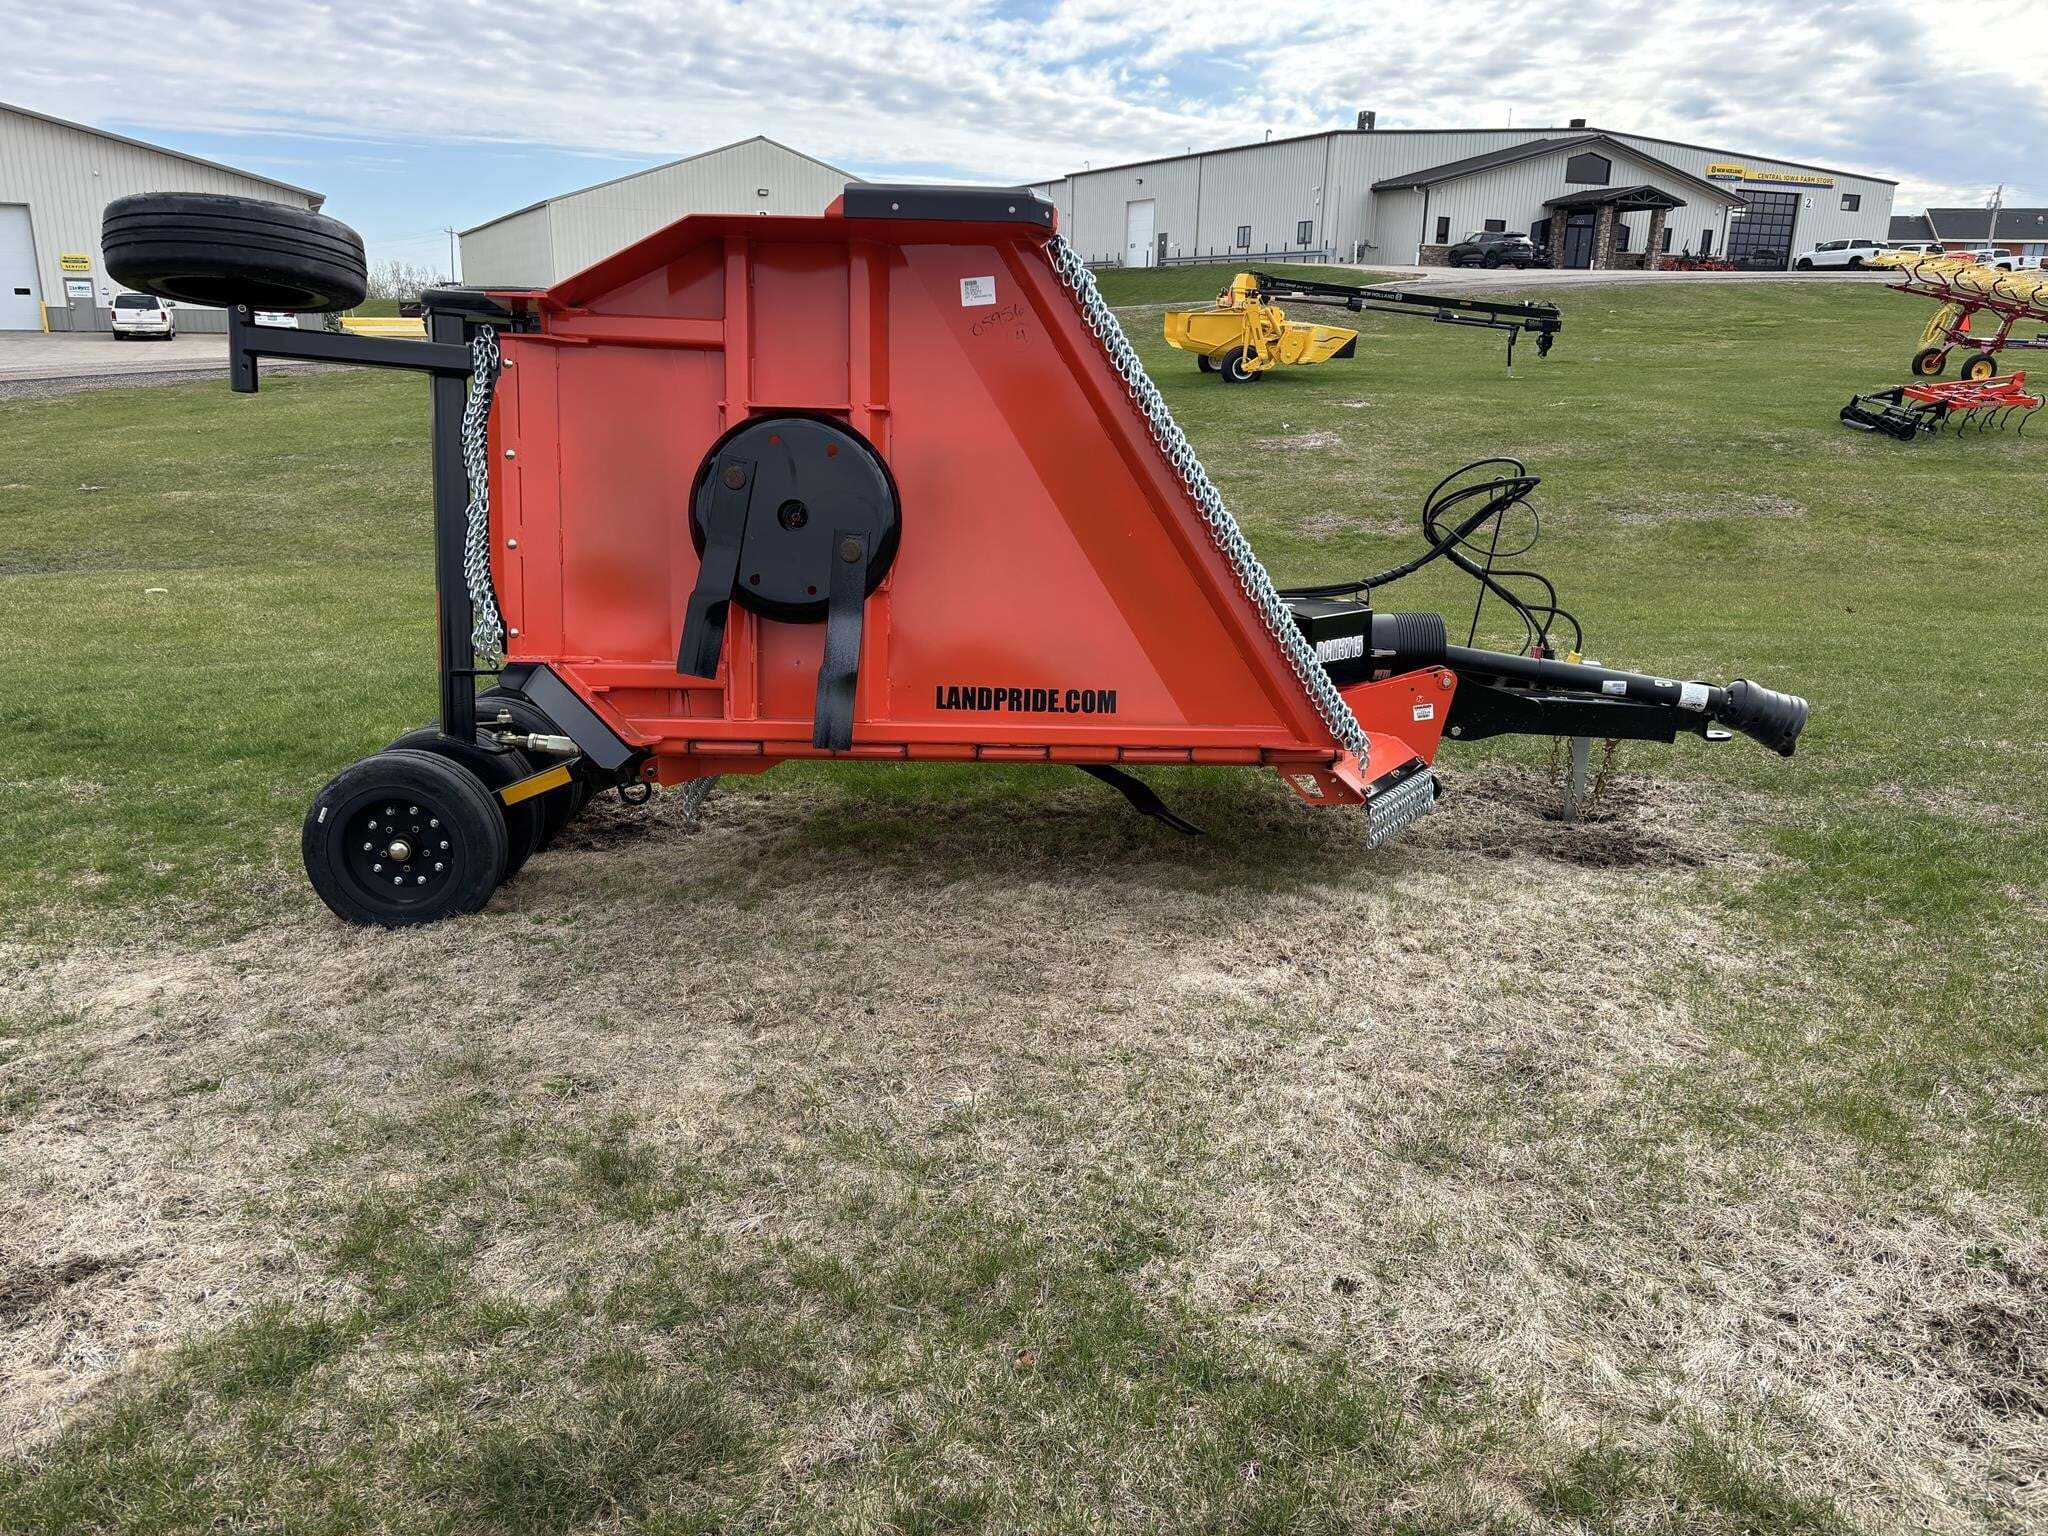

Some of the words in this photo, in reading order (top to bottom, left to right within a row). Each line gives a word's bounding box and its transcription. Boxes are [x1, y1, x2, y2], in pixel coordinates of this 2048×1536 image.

[1816, 177, 1835, 185] STORE
[1805, 198, 1812, 208] 2
[935, 685, 1118, 715] LANDPRIDE.COM
